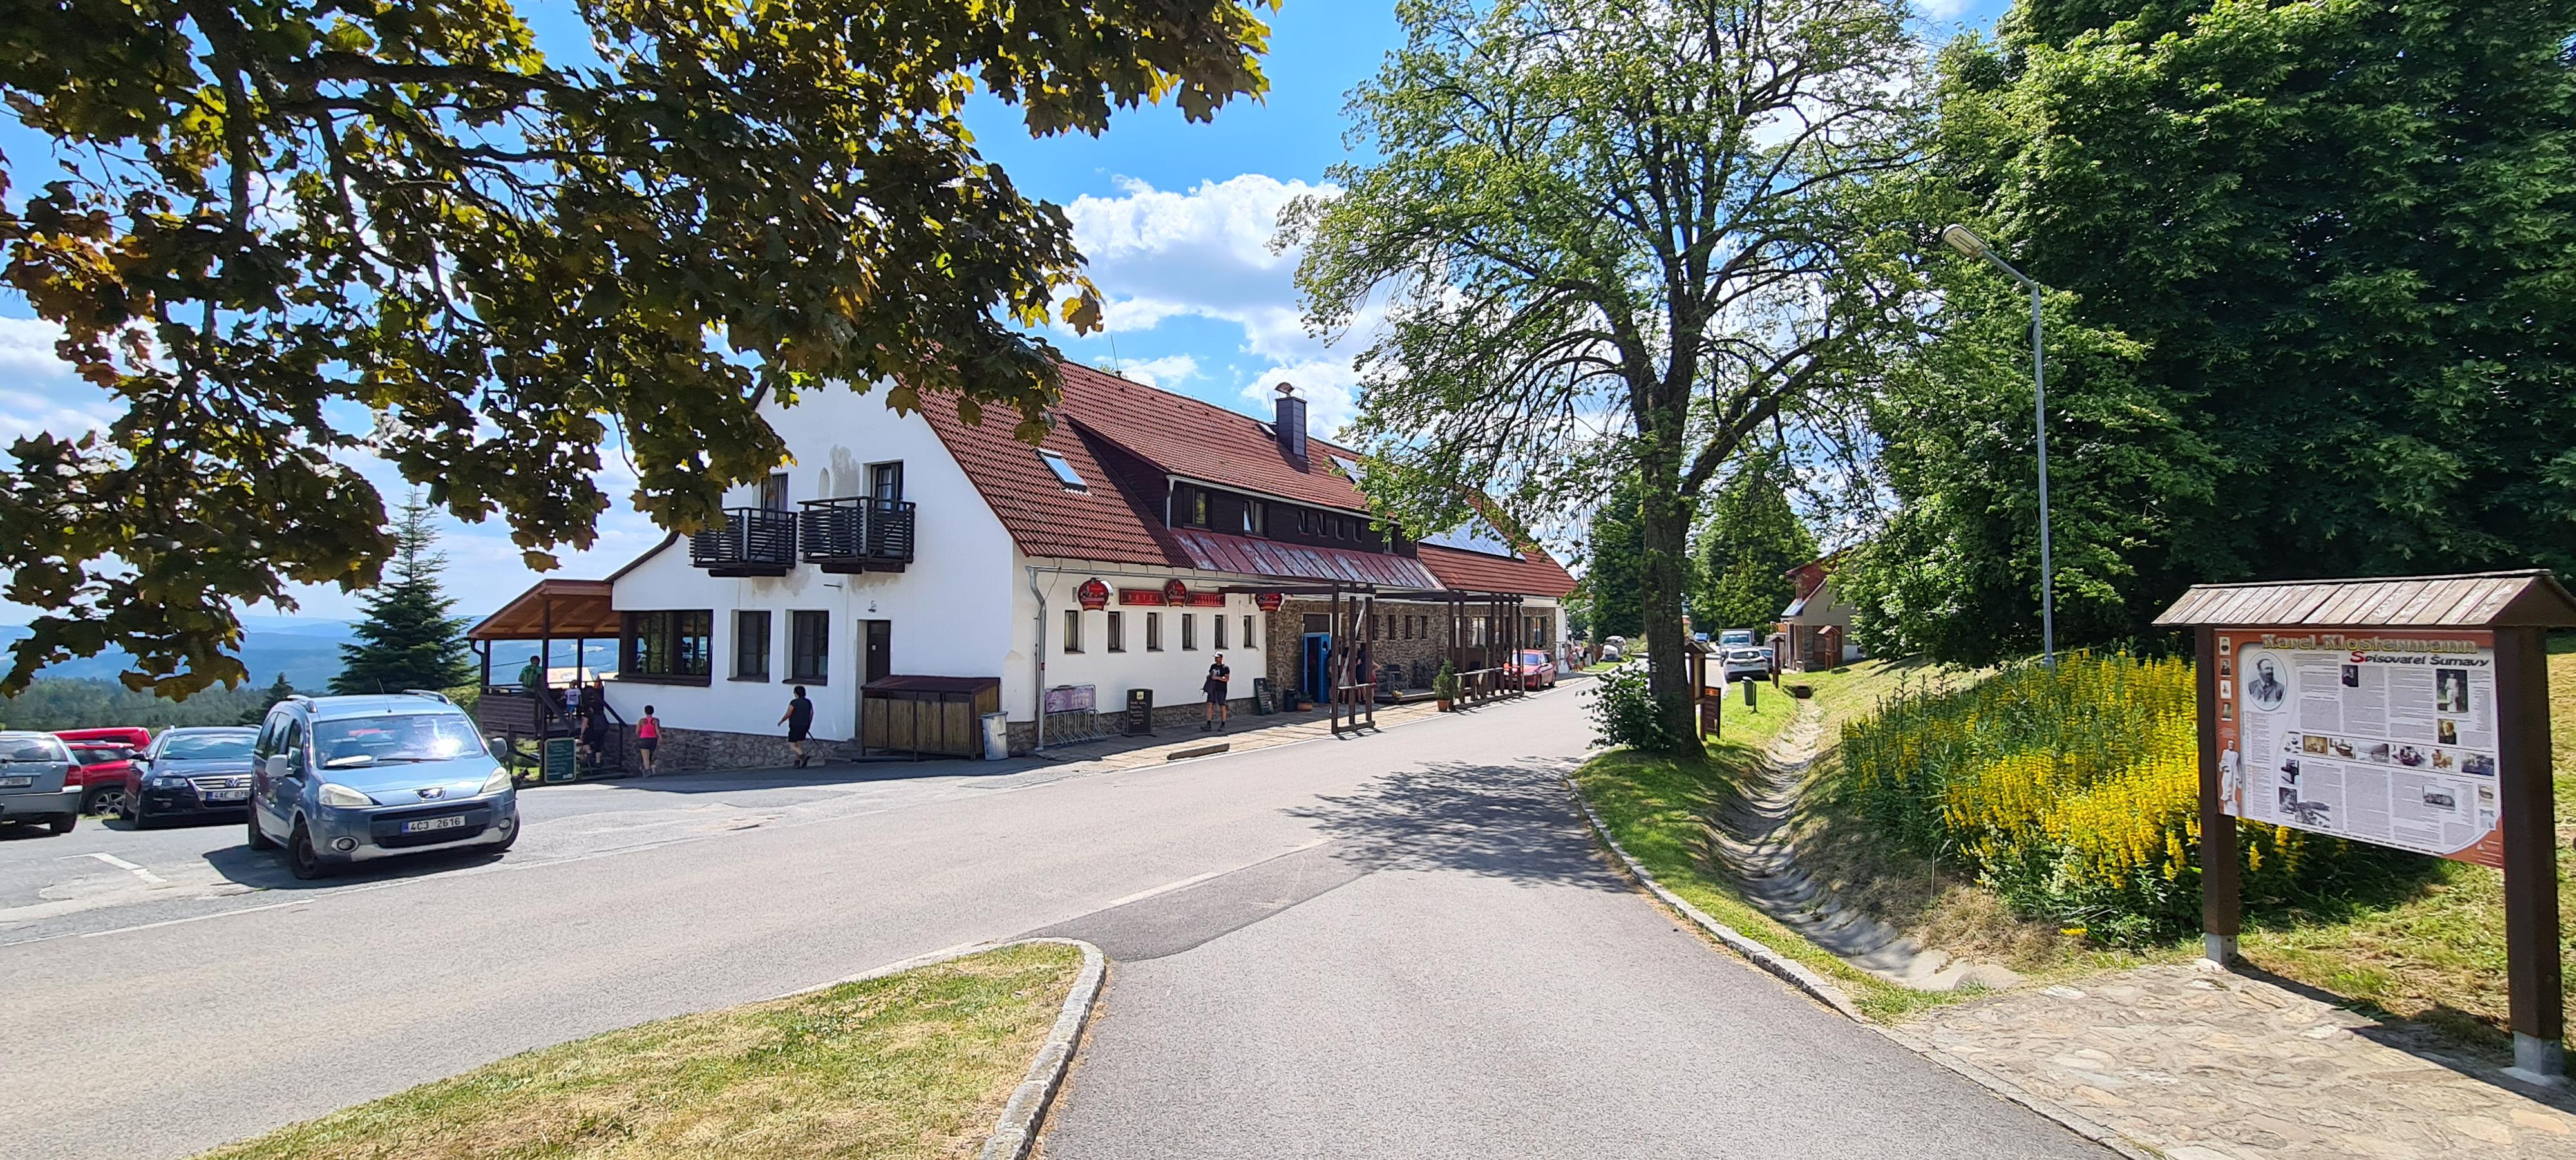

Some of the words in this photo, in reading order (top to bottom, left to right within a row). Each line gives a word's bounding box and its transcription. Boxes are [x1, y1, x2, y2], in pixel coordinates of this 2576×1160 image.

[1128, 593, 1159, 602] HOTEL
[2260, 633, 2317, 650] Karel
[2321, 634, 2479, 654] Klostermann
[2349, 651, 2426, 665] Spisovatel
[2429, 654, 2490, 667] Šumavy
[410, 821, 430, 831] 4C3
[437, 817, 461, 828] 2616
